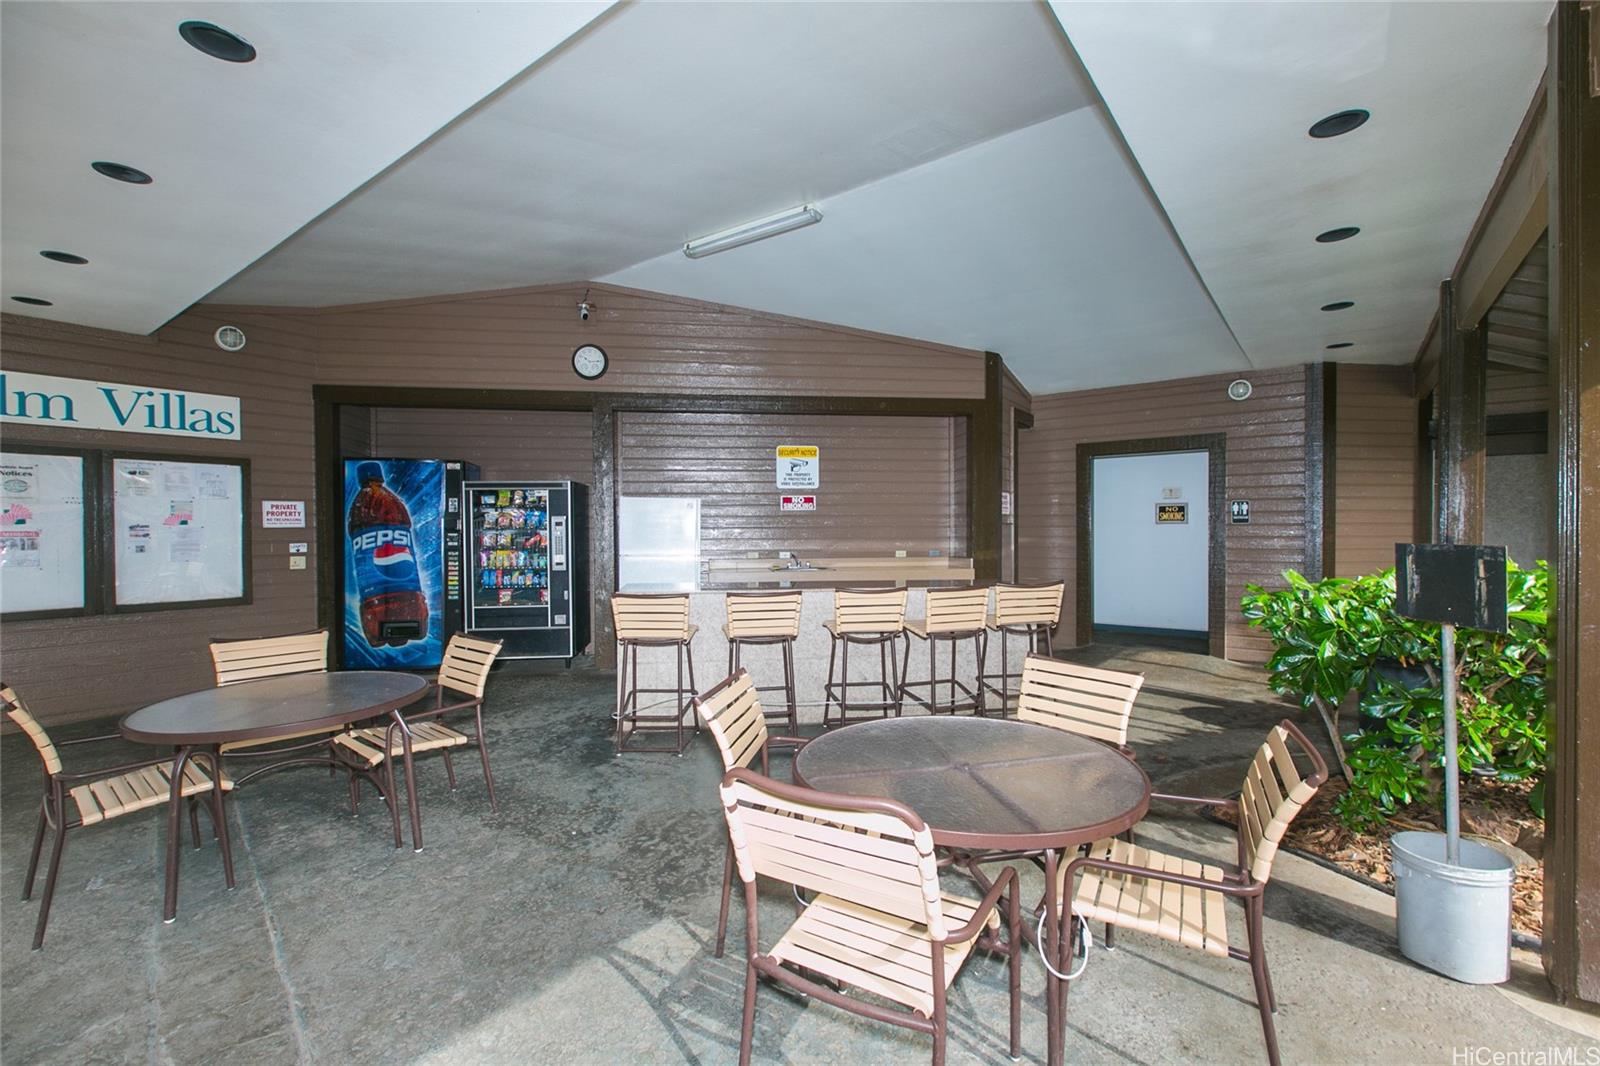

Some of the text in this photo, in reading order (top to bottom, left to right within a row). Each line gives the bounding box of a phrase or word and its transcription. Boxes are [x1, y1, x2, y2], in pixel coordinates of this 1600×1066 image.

[97, 387, 235, 435] Villas
[783, 502, 815, 510] SMOKING
[1159, 511, 1184, 520] SMOKING
[353, 530, 411, 555] PEPSI
